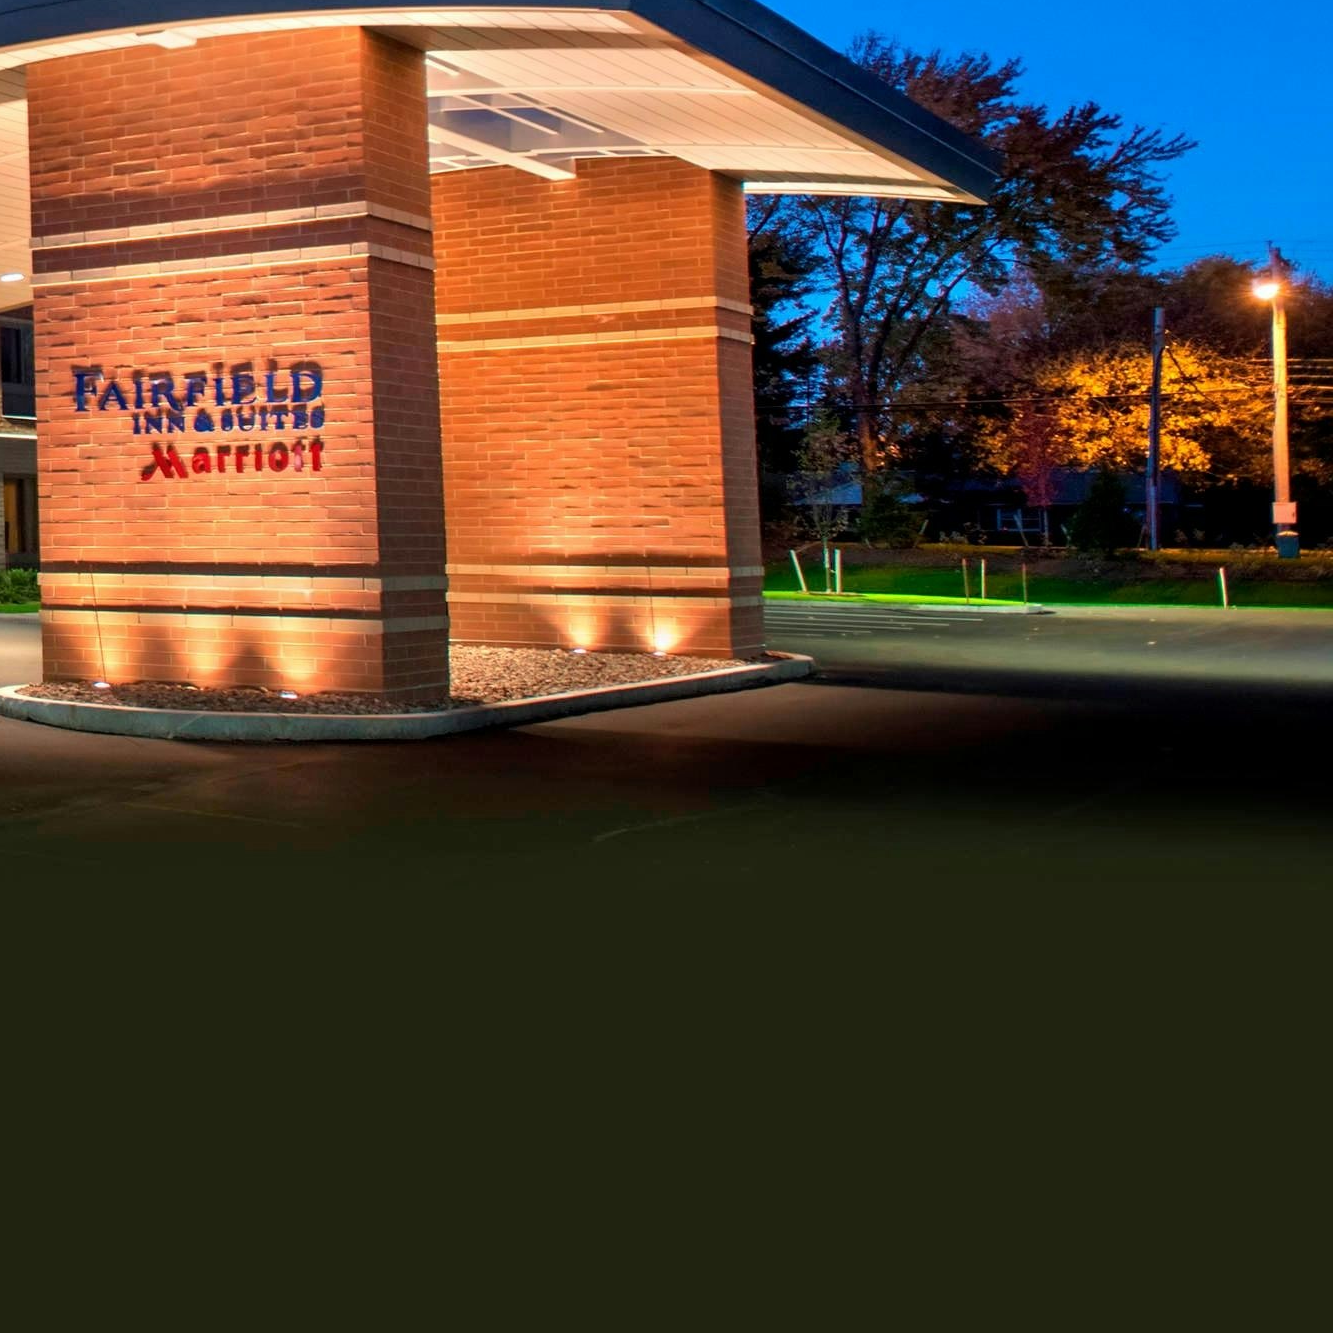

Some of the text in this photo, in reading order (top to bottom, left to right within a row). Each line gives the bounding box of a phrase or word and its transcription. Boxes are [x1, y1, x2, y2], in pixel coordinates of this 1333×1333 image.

[72, 369, 324, 413] FAIRFIELD
[133, 410, 186, 435] INN
[220, 405, 325, 433] SUITES
[140, 440, 324, 482] Marriott
